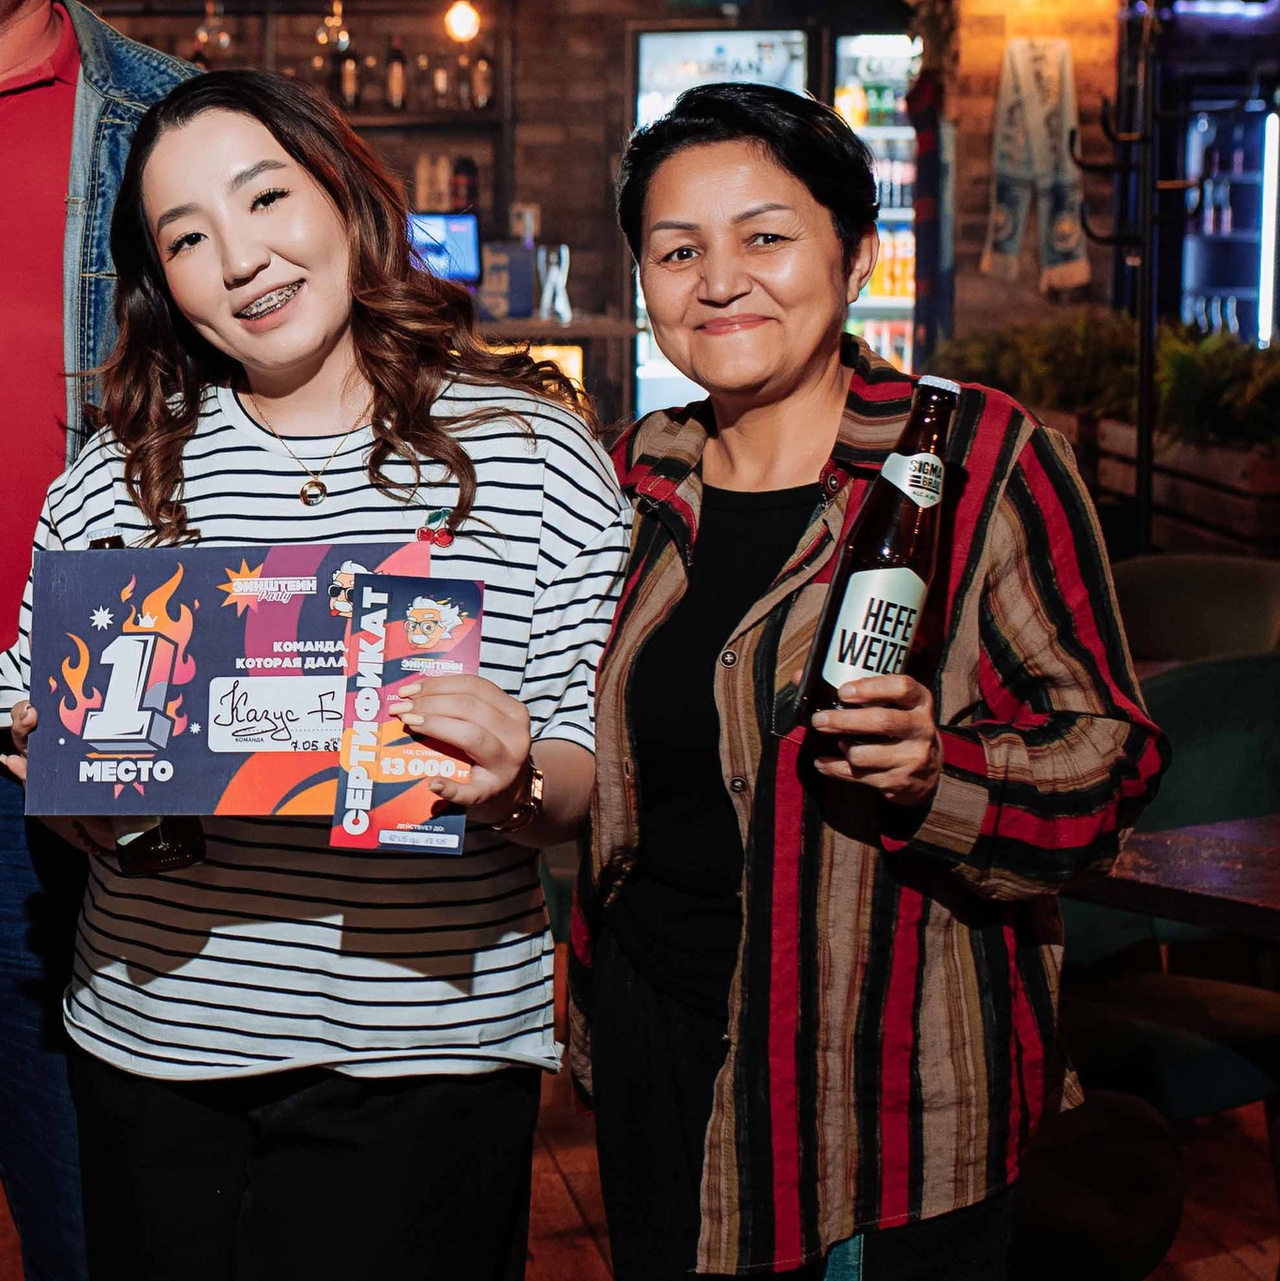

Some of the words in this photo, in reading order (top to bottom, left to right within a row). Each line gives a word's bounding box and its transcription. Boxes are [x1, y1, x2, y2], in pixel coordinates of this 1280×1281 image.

[910, 460, 943, 479] SIGMA
[257, 589, 293, 604] Party
[862, 596, 918, 643] HEFE
[272, 640, 349, 653] КОМАНДА,
[235, 657, 302, 669] КОТОРАЯ
[303, 656, 349, 669] ДАЛА
[213, 680, 300, 742] Казус
[342, 586, 390, 836] СЕРТИФИКАТ
[402, 748, 414, 756] НА
[78, 759, 175, 783] МЕСТО
[380, 757, 406, 776] 13
[407, 758, 456, 778] 000
[396, 822, 433, 831] ДЕЙСТВУЕТ
